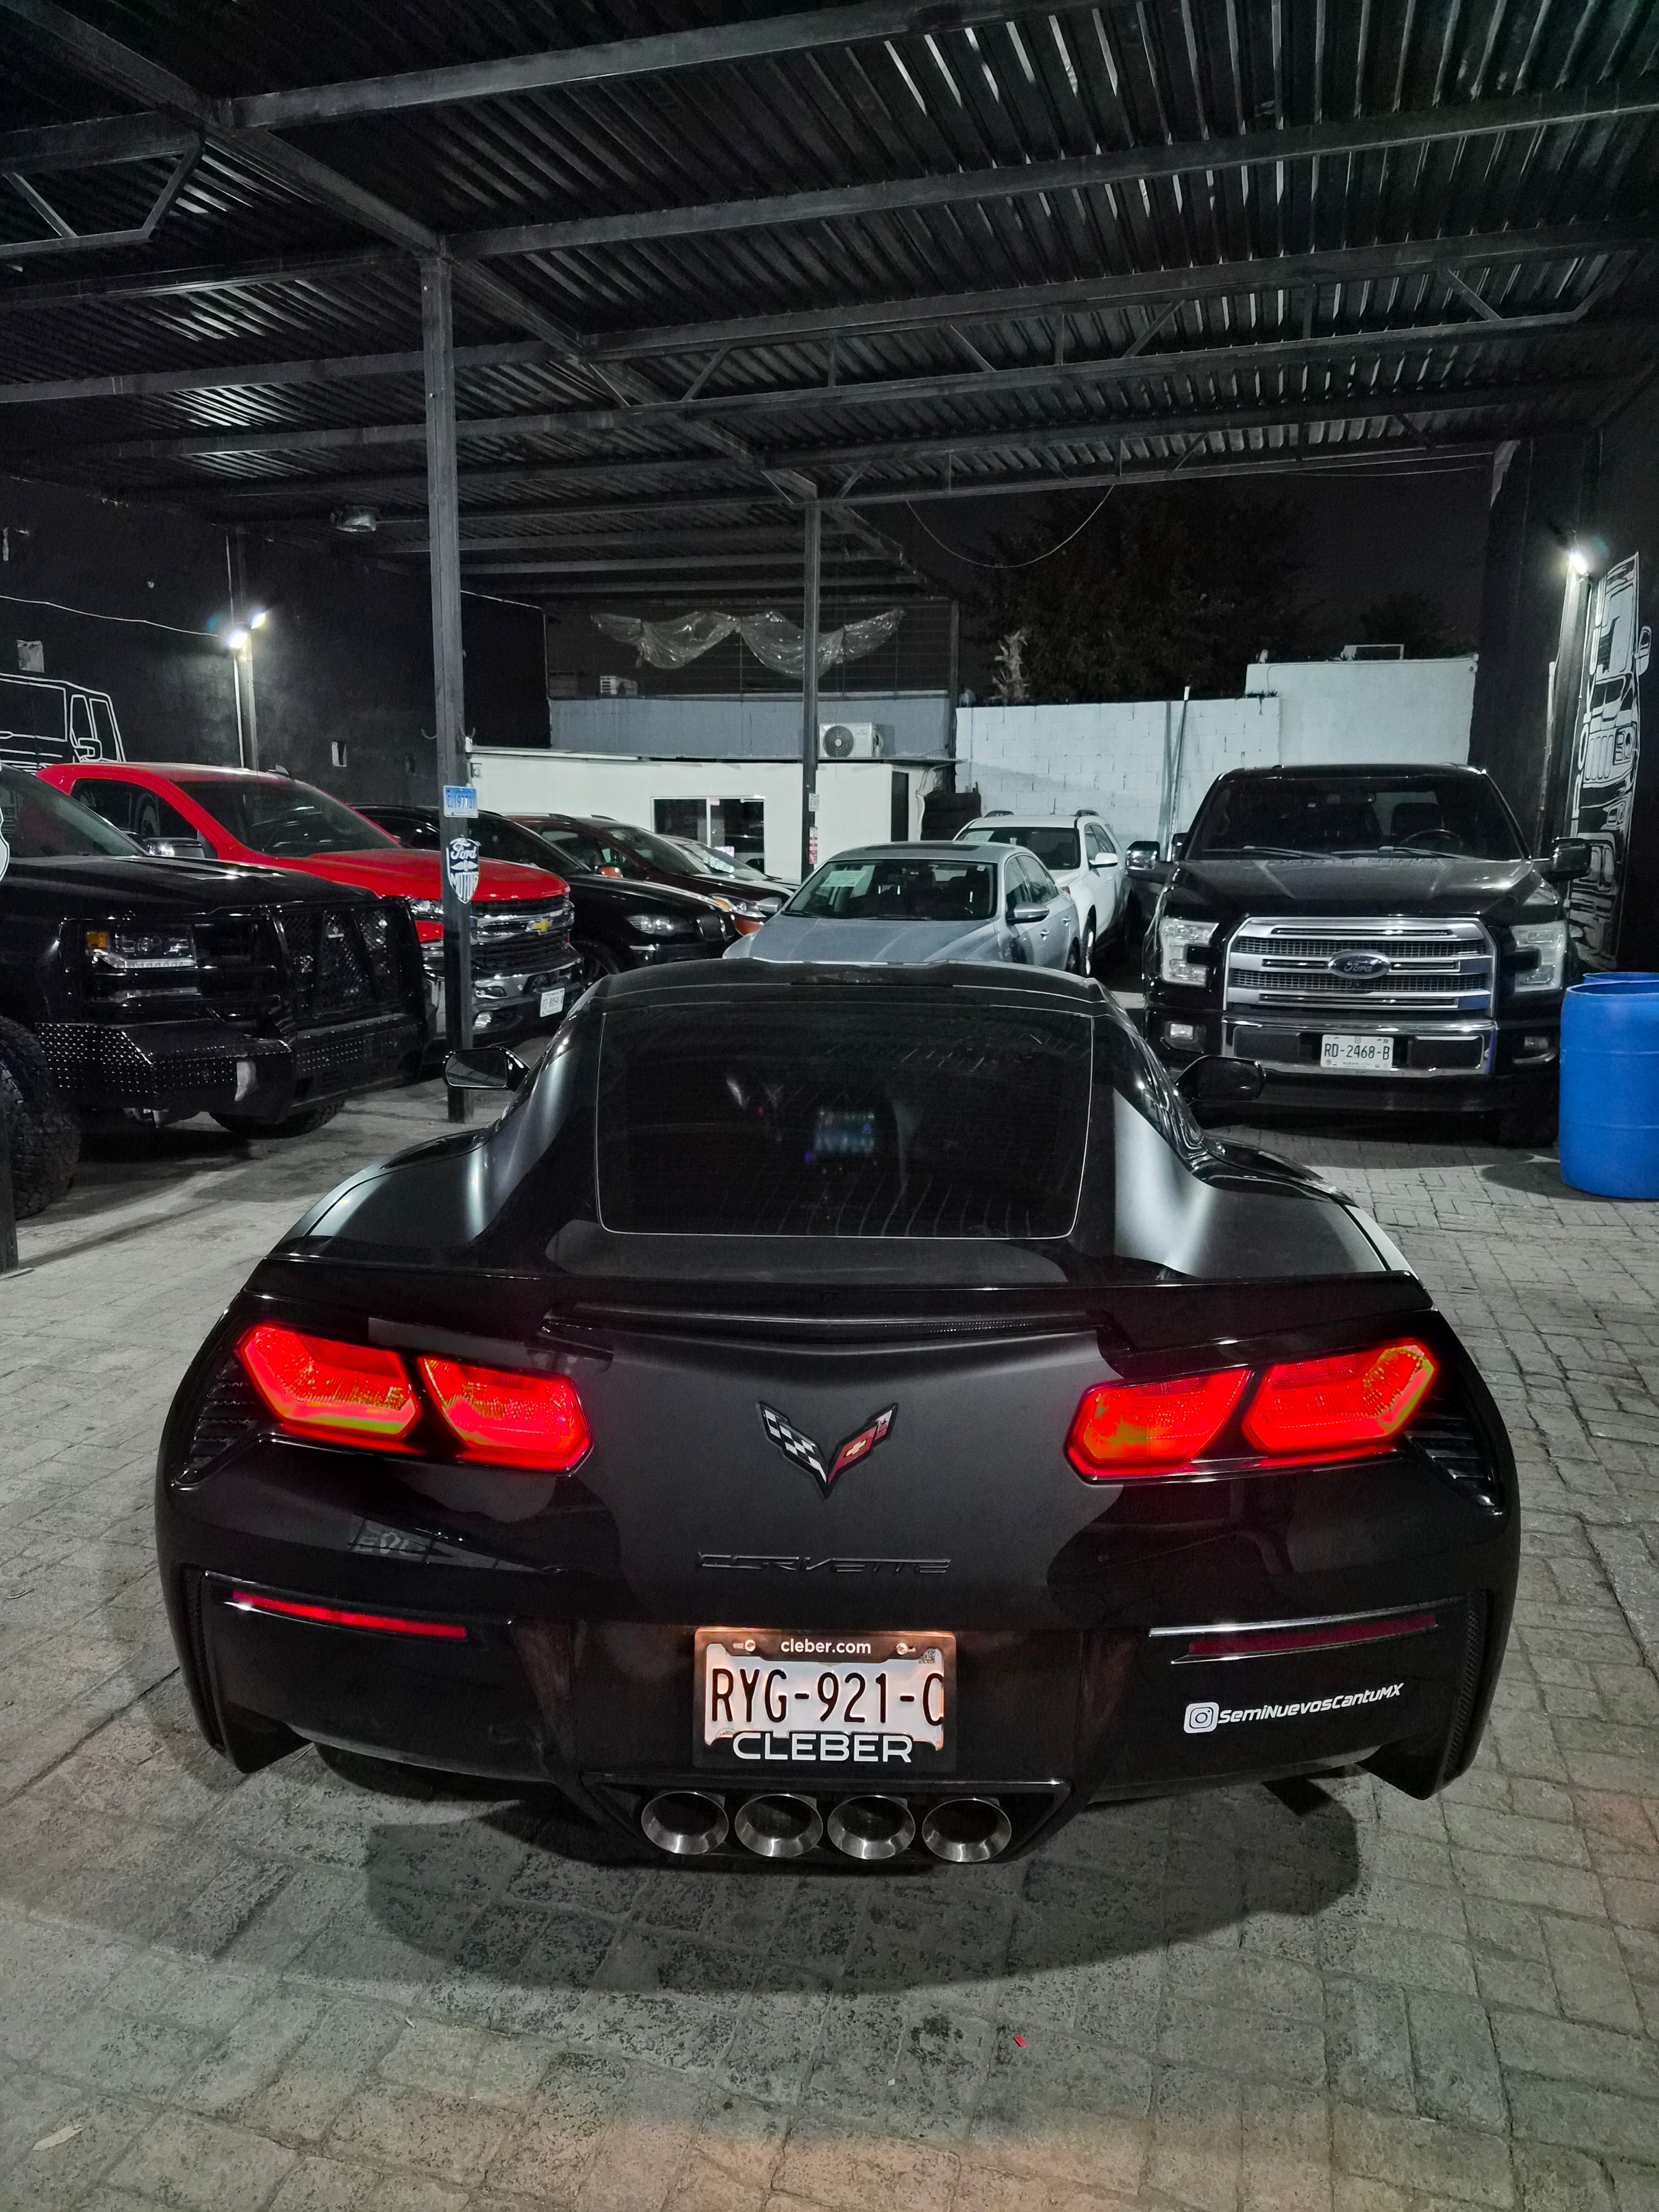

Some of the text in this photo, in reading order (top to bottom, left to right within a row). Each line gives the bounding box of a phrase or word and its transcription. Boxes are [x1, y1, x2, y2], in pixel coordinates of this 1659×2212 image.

[450, 843, 477, 860] Ford
[1344, 961, 1373, 972] Ford
[1324, 1043, 1390, 1060] RD-2468-B
[697, 1552, 951, 1573] CORVETTE
[781, 1638, 871, 1655] cleber.com
[733, 1733, 913, 1763] CLEBER
